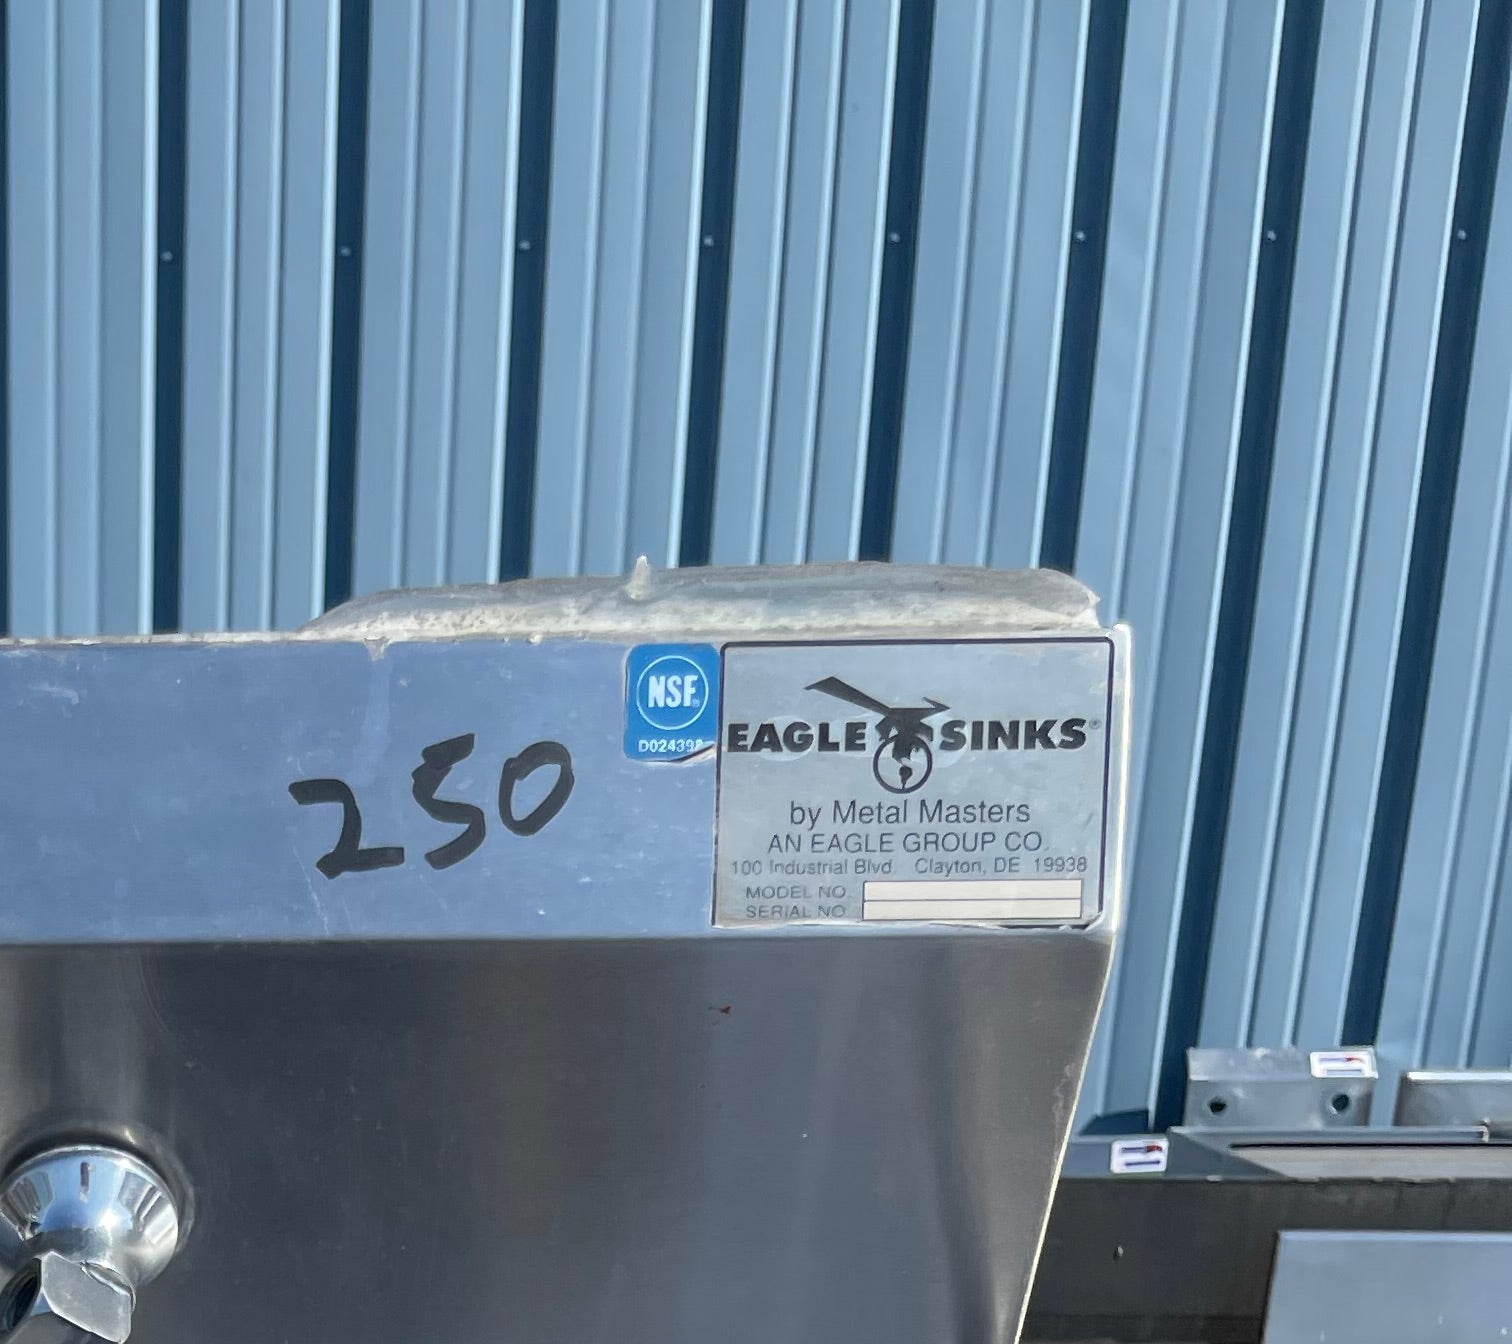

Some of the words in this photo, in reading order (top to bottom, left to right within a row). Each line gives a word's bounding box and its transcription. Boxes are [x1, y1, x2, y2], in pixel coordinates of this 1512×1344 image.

[648, 674, 699, 708] NSF
[727, 721, 867, 753] EAGLE
[288, 733, 575, 880] 250
[790, 800, 822, 831] by
[832, 799, 908, 824] Metal
[919, 799, 1031, 824] Masters
[768, 833, 802, 854] AN
[810, 832, 895, 853] EAGLE
[902, 831, 996, 853] GROUP
[732, 859, 763, 876] 100
[769, 859, 848, 875] Industrial
[914, 857, 987, 877] Clayton,
[993, 856, 1021, 873] DE
[1034, 856, 1088, 873] 19938
[745, 885, 813, 899] MODEL
[745, 904, 812, 918] SERIAL
